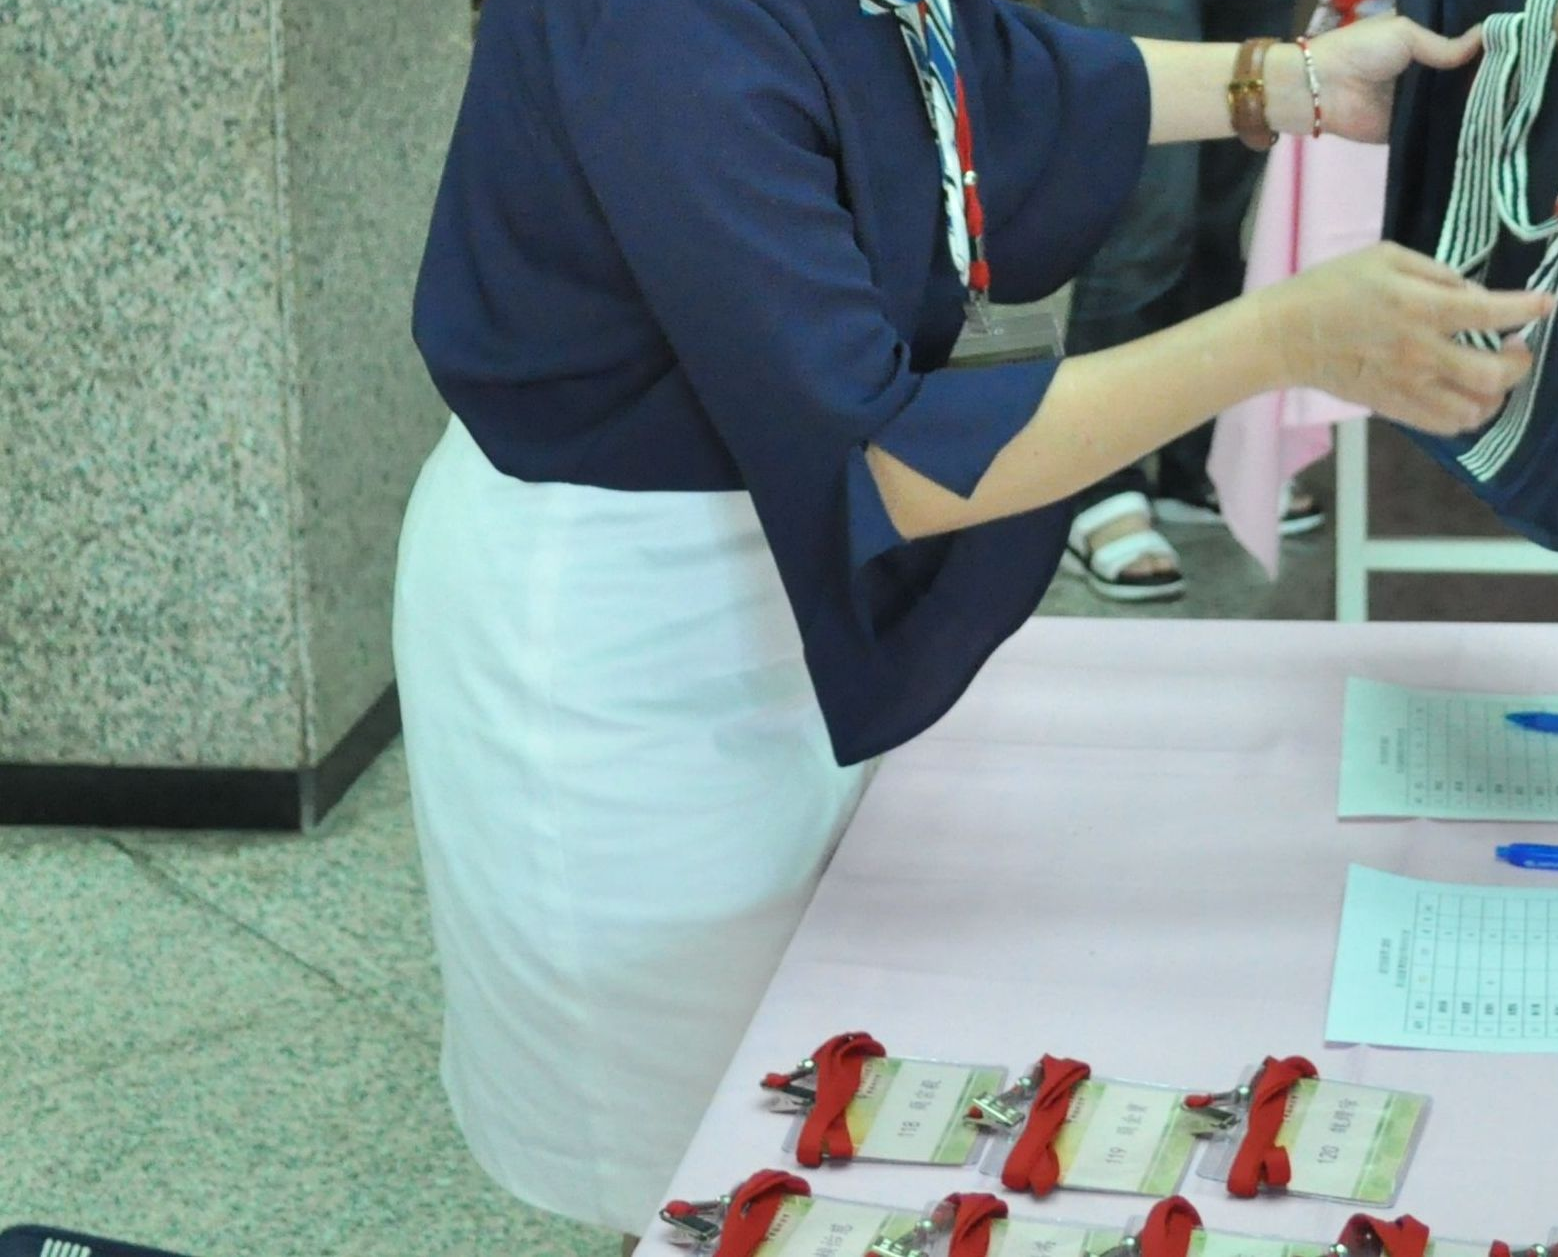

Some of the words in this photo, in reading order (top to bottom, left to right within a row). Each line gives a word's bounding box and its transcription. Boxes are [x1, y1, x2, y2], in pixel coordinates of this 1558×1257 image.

[897, 1121, 921, 1137] 118
[1104, 1146, 1127, 1164] 119
[1317, 1145, 1339, 1164] 120
